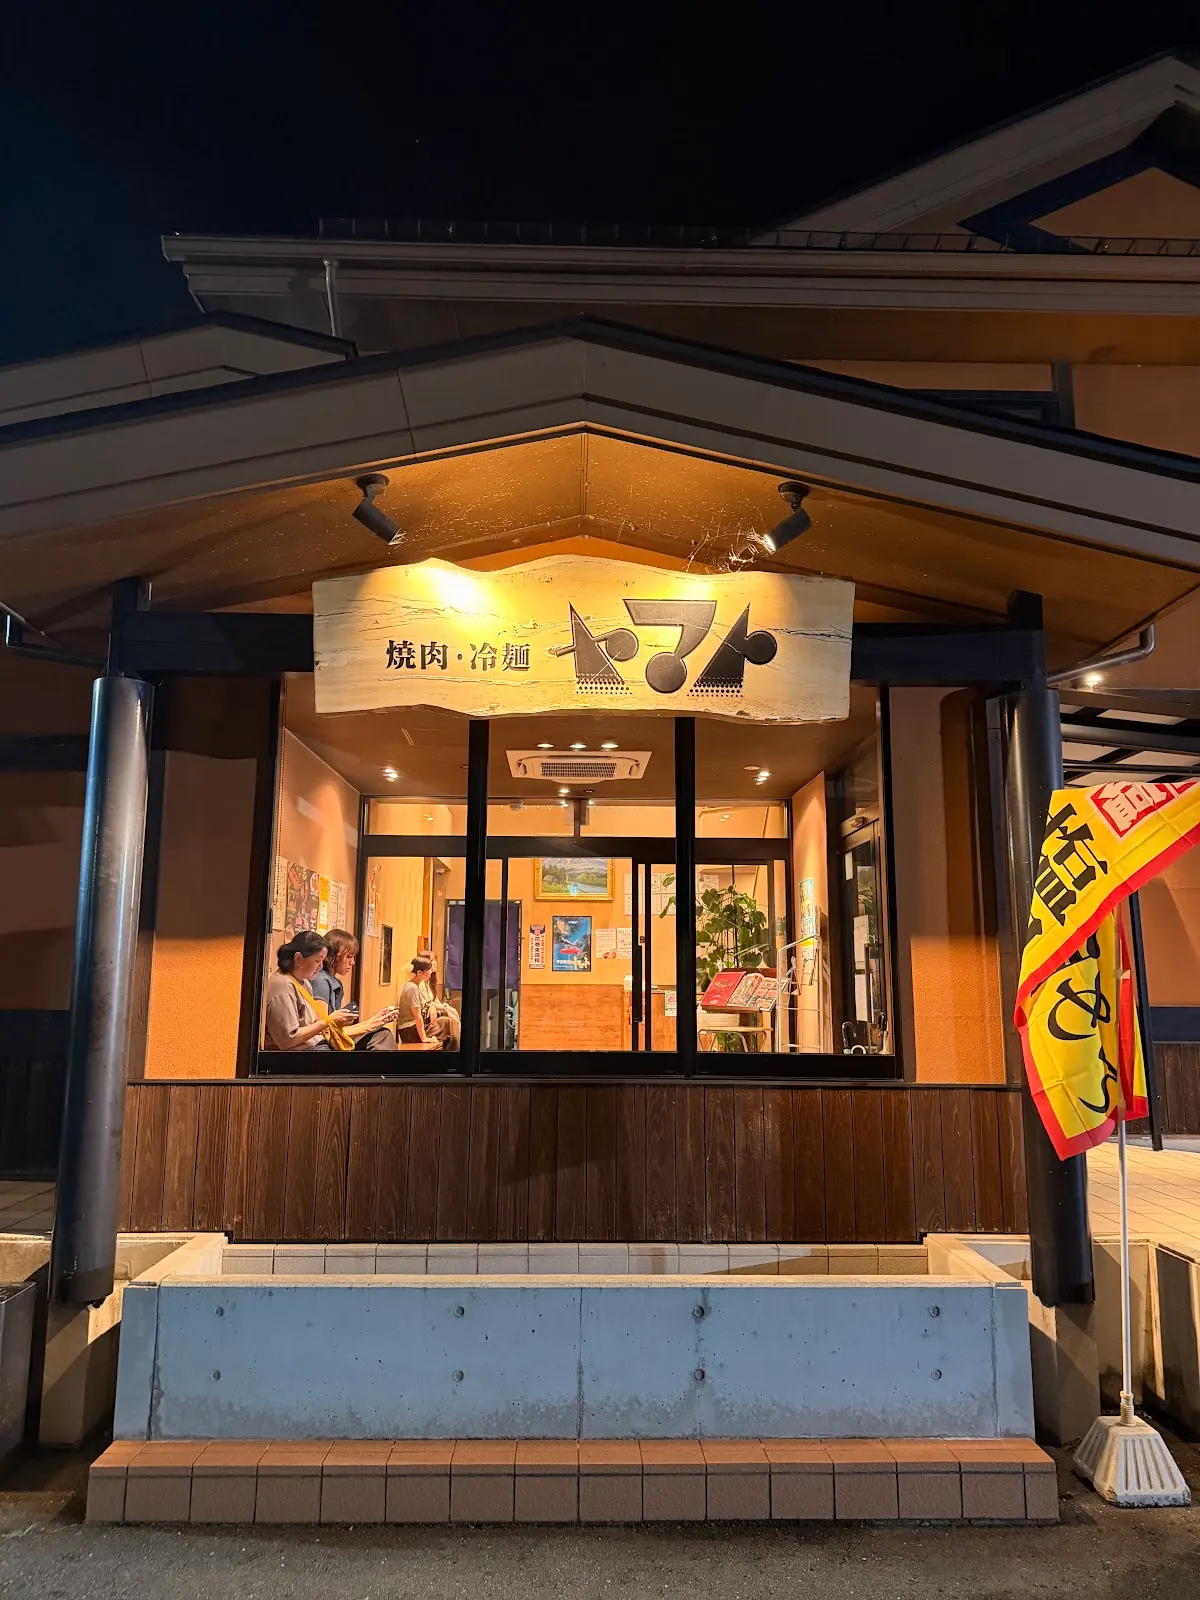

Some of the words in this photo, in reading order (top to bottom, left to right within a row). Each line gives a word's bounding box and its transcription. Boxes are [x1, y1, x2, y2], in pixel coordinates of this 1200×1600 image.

[386, 640, 530, 672] 焼肉・冷麺
[549, 599, 777, 697] ヤマト
